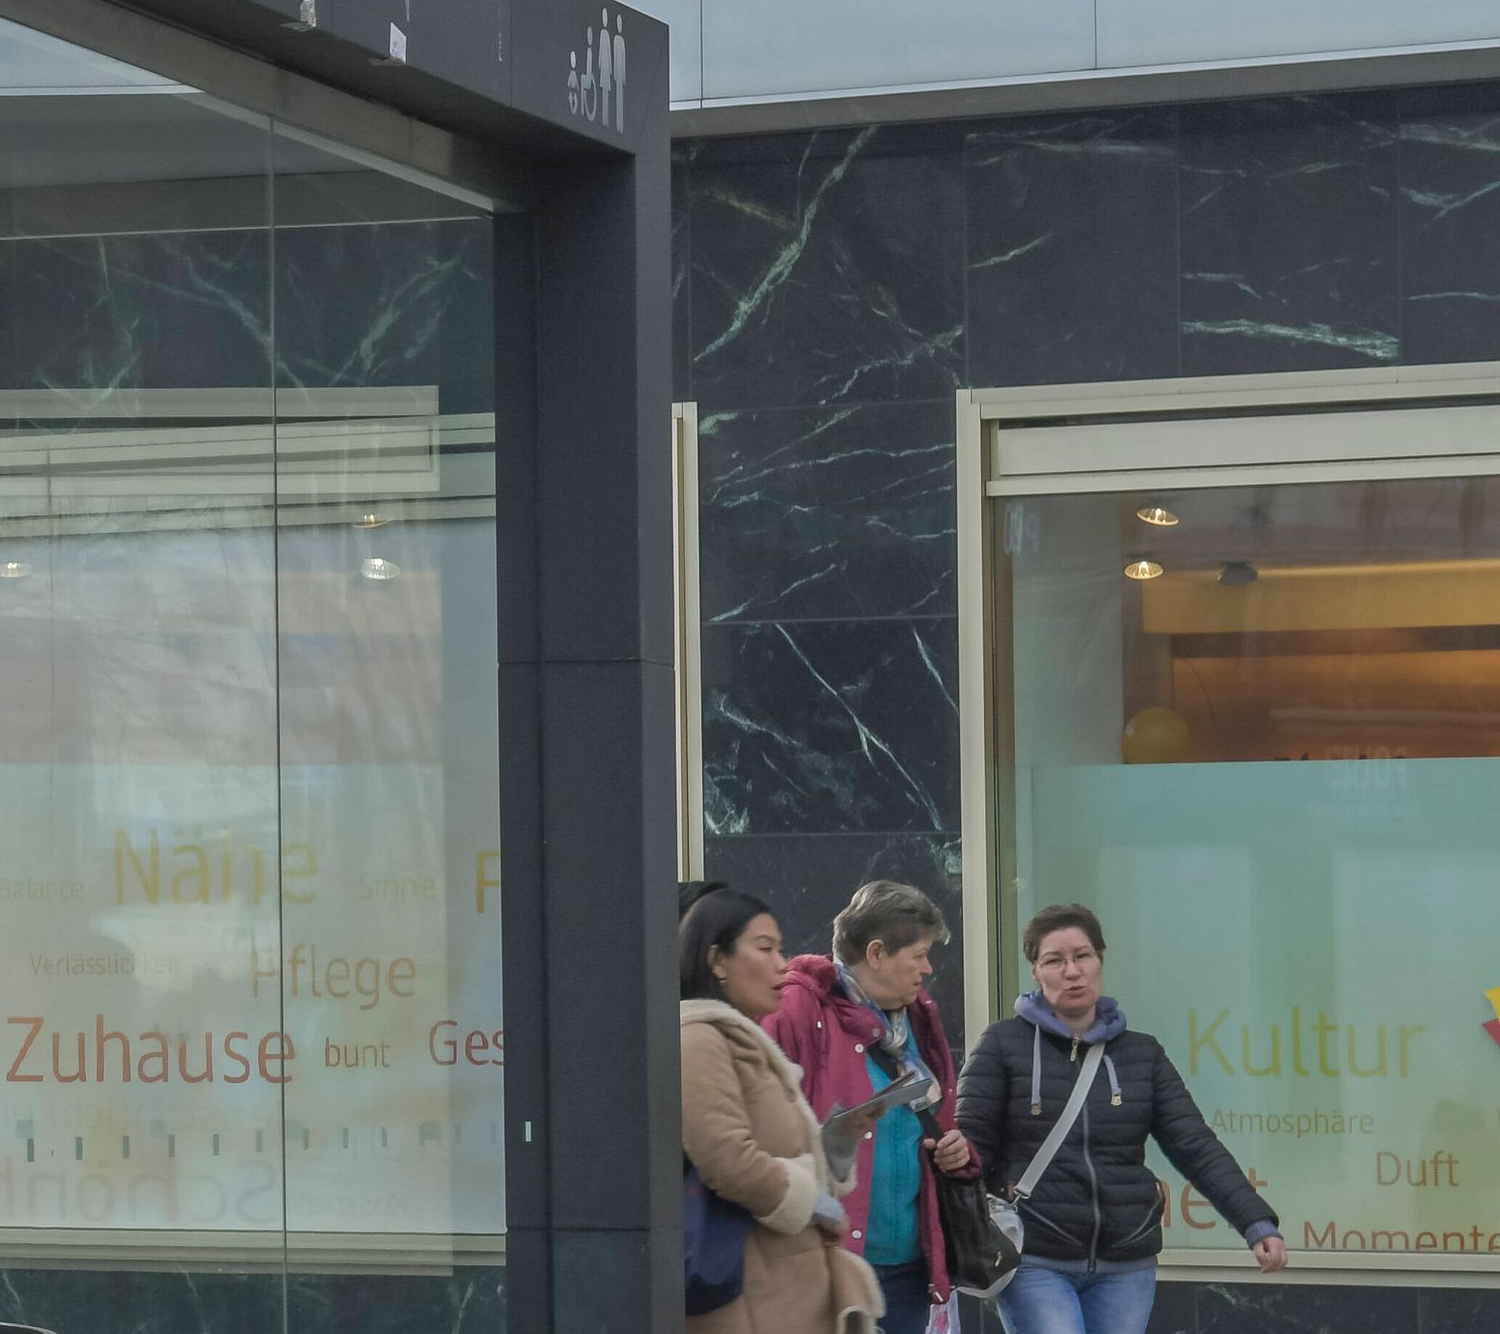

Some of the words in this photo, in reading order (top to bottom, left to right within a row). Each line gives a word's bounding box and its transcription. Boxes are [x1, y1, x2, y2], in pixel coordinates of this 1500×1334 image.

[111, 825, 319, 907] Nähe
[250, 942, 417, 1011] Pflege
[4, 1013, 297, 1086] Zuhause
[323, 1036, 391, 1068] bunt
[1189, 1005, 1427, 1079] Kultur
[1211, 1107, 1375, 1140] Atmosphäre
[1375, 1150, 1460, 1188] Duft
